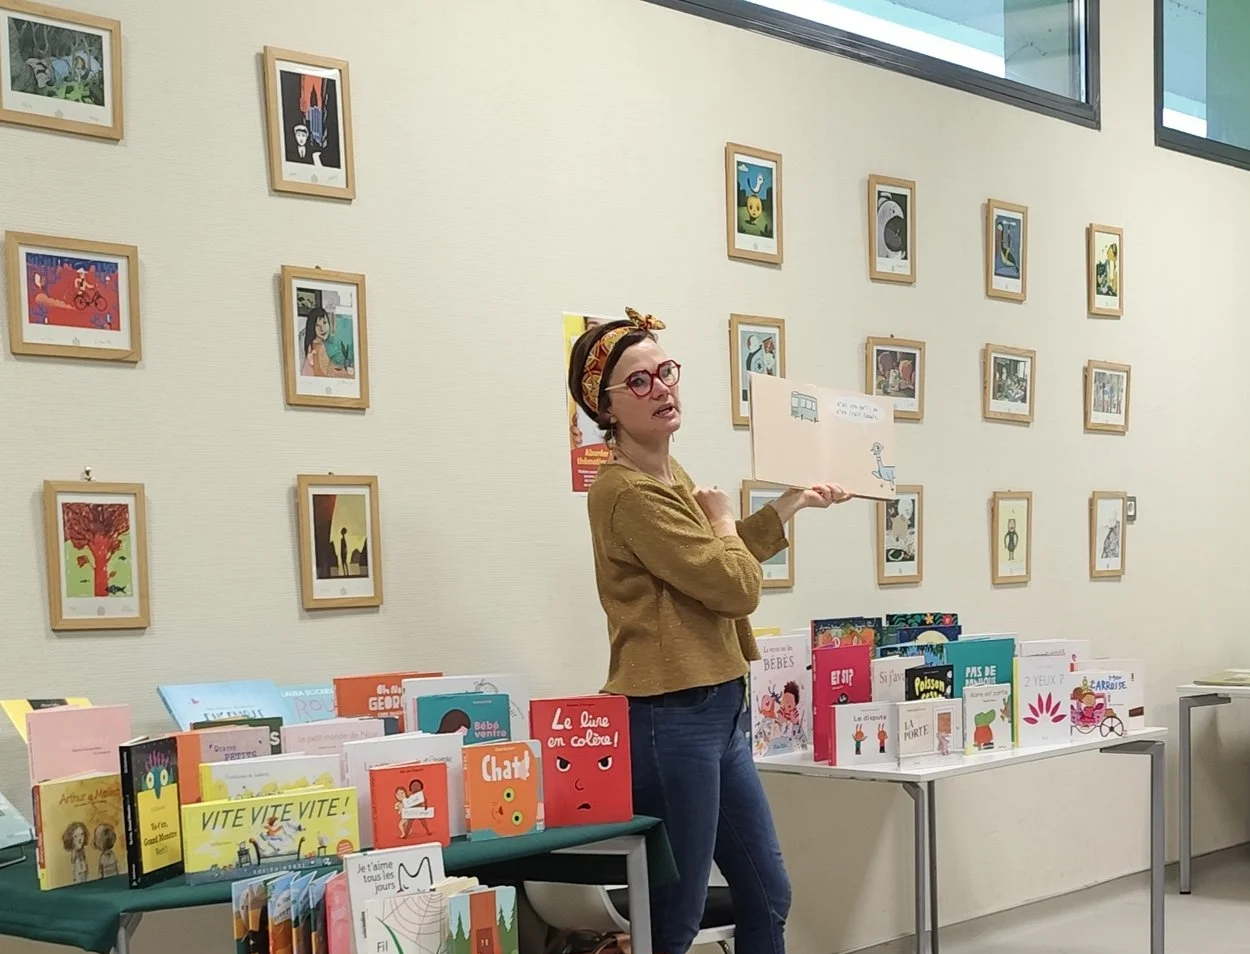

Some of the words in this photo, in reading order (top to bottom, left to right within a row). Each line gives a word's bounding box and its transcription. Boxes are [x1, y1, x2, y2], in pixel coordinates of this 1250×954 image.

[965, 665, 982, 678] PAS
[985, 665, 997, 676] DE
[914, 675, 945, 696] Poisson
[1024, 675, 1031, 688] 2
[1033, 674, 1056, 687] YEUX
[1059, 673, 1065, 685] ?
[294, 696, 337, 720] ROU
[551, 707, 573, 730] Le
[580, 710, 610, 728] livre
[863, 713, 887, 721] dispute
[474, 721, 500, 731] Bébé
[904, 719, 914, 731] LA
[474, 729, 507, 738] ventre
[904, 724, 929, 741] PORTE
[547, 736, 566, 749] en
[201, 807, 246, 832] VITE
[250, 803, 294, 826] VITE
[299, 797, 340, 821] VITE
[342, 796, 350, 815] !
[357, 863, 366, 875] Je
[367, 861, 394, 873] t'aime
[363, 872, 382, 883] tous
[383, 870, 395, 880] les
[375, 882, 396, 896] jours
[377, 941, 388, 952] Fil
